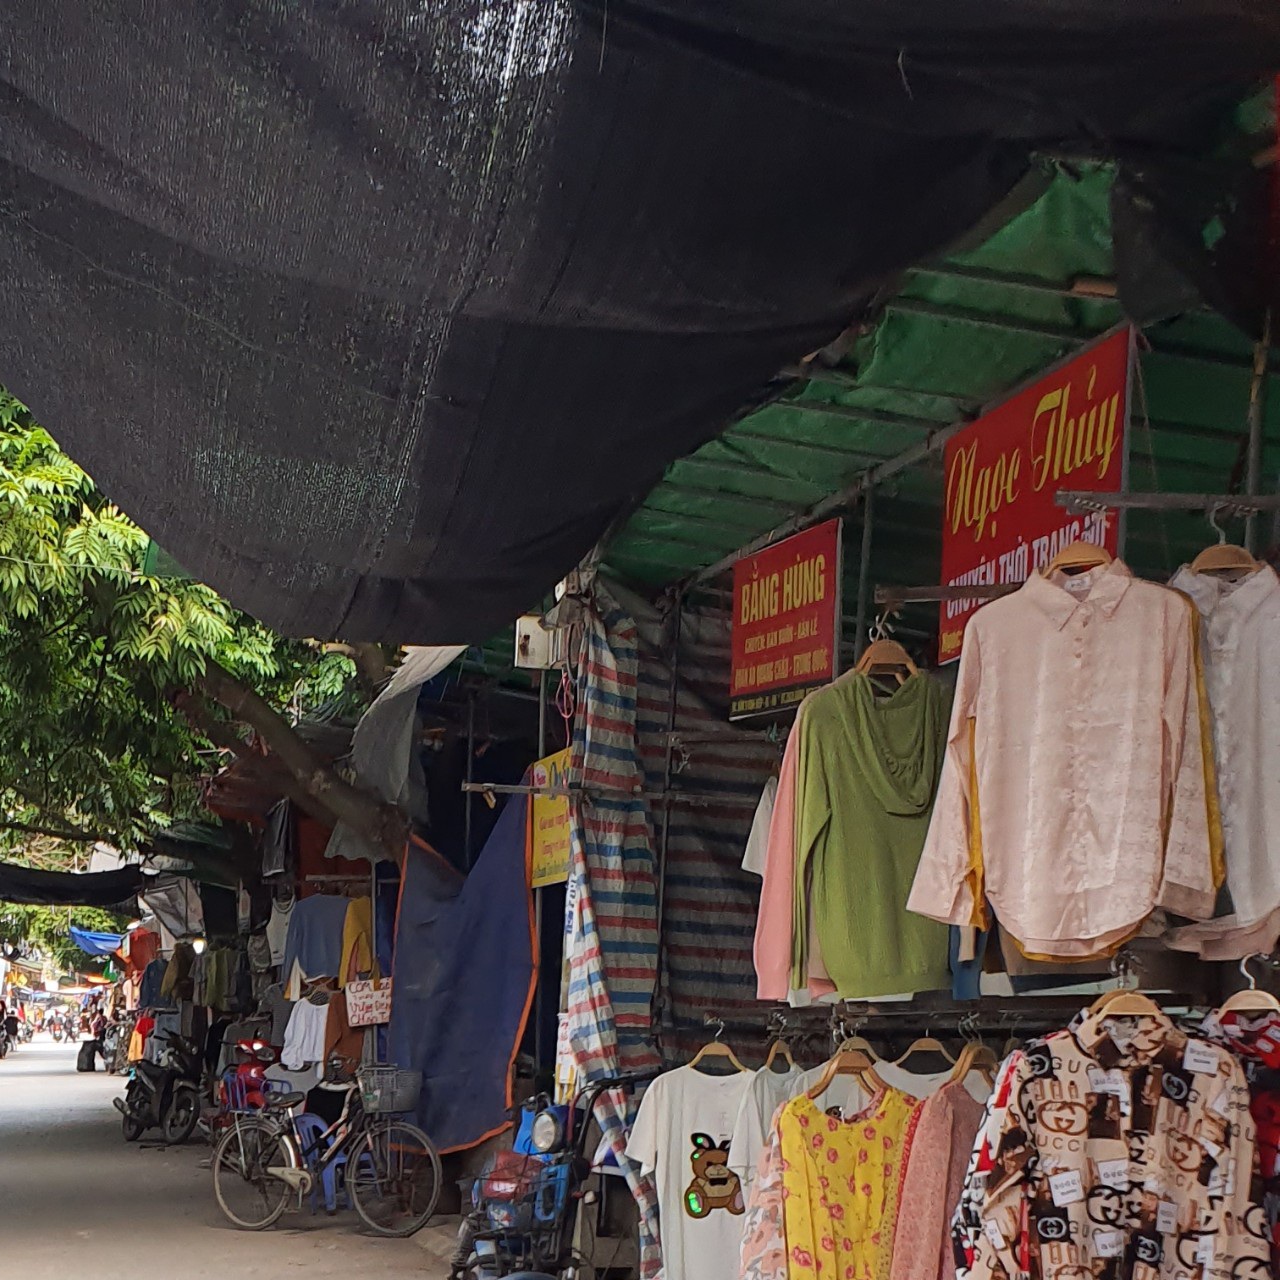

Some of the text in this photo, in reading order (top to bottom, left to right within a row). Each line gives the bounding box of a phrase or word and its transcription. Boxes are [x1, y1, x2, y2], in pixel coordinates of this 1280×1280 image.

[946, 364, 1119, 542] Ngọc Thủy
[740, 553, 826, 626] BẰNG HÙNG
